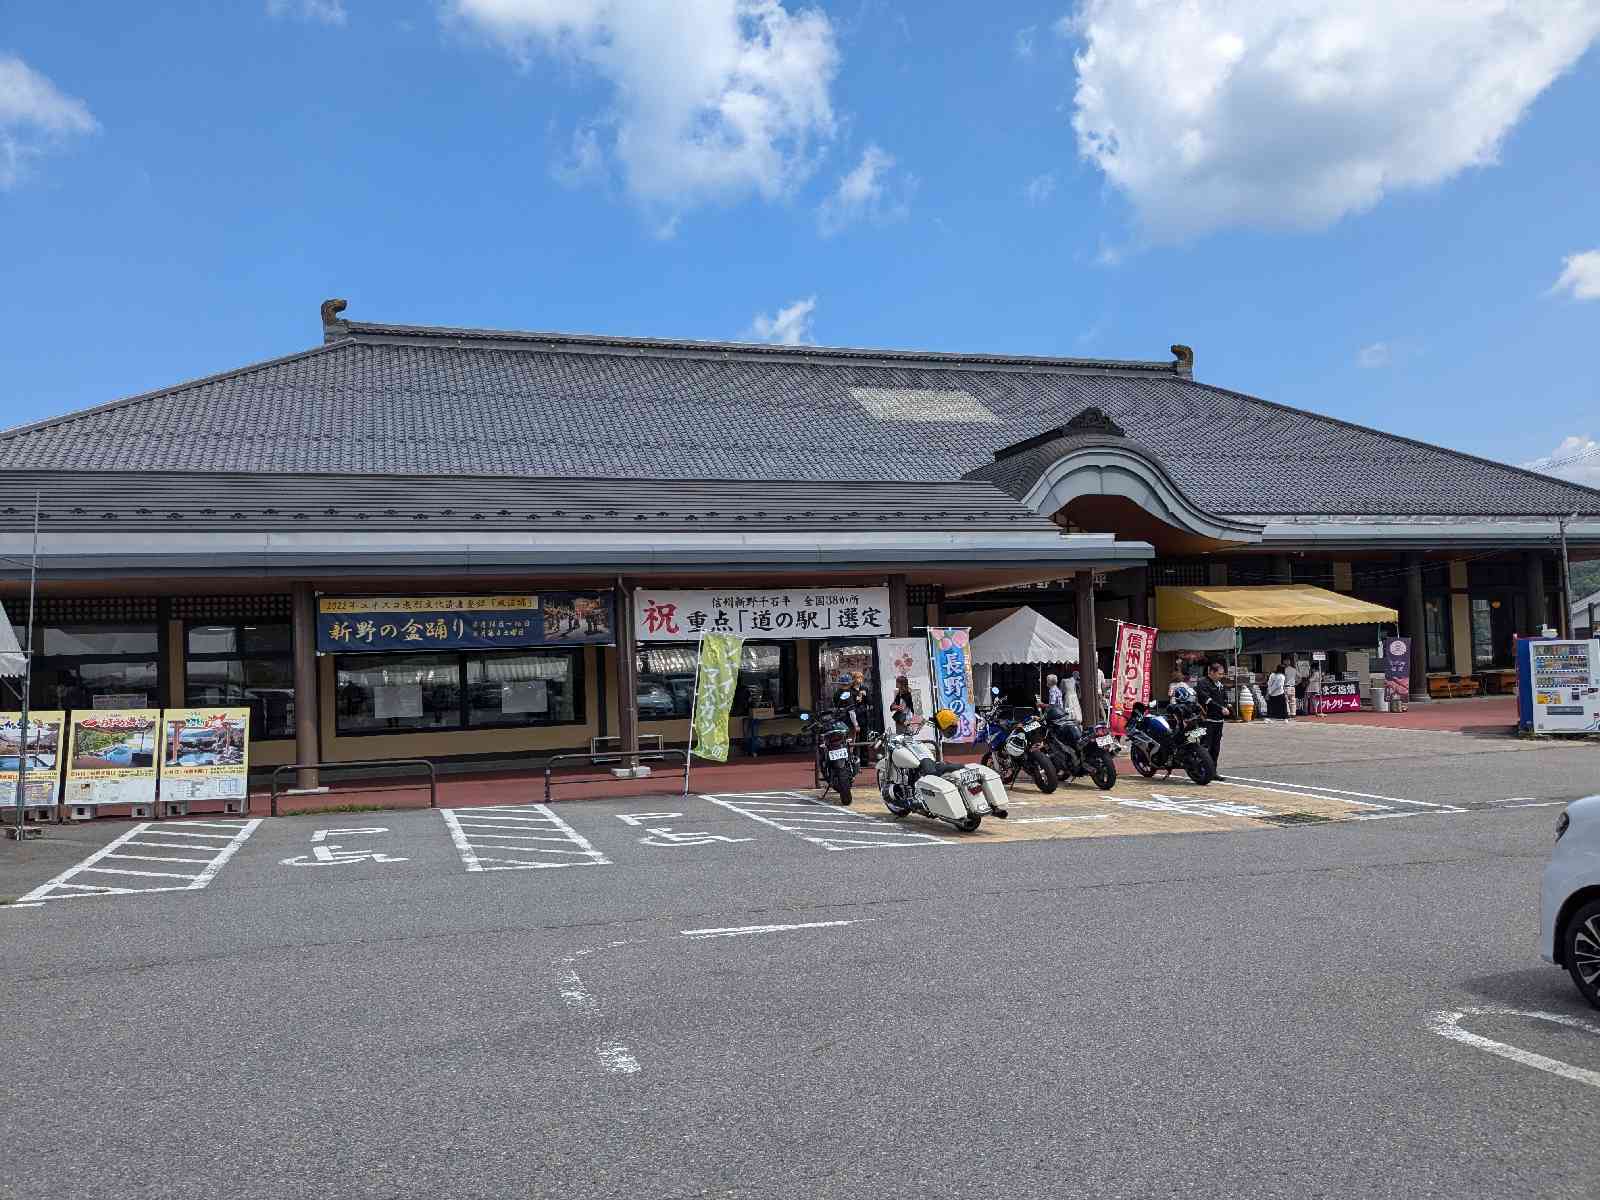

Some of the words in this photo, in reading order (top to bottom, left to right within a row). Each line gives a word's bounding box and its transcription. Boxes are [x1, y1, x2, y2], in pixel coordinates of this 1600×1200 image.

[712, 595, 791, 608] 信州新野千石平
[641, 600, 679, 634] 祝
[686, 606, 883, 632] 重点「道の駅」選定
[328, 618, 464, 642] 新野の盆踊り
